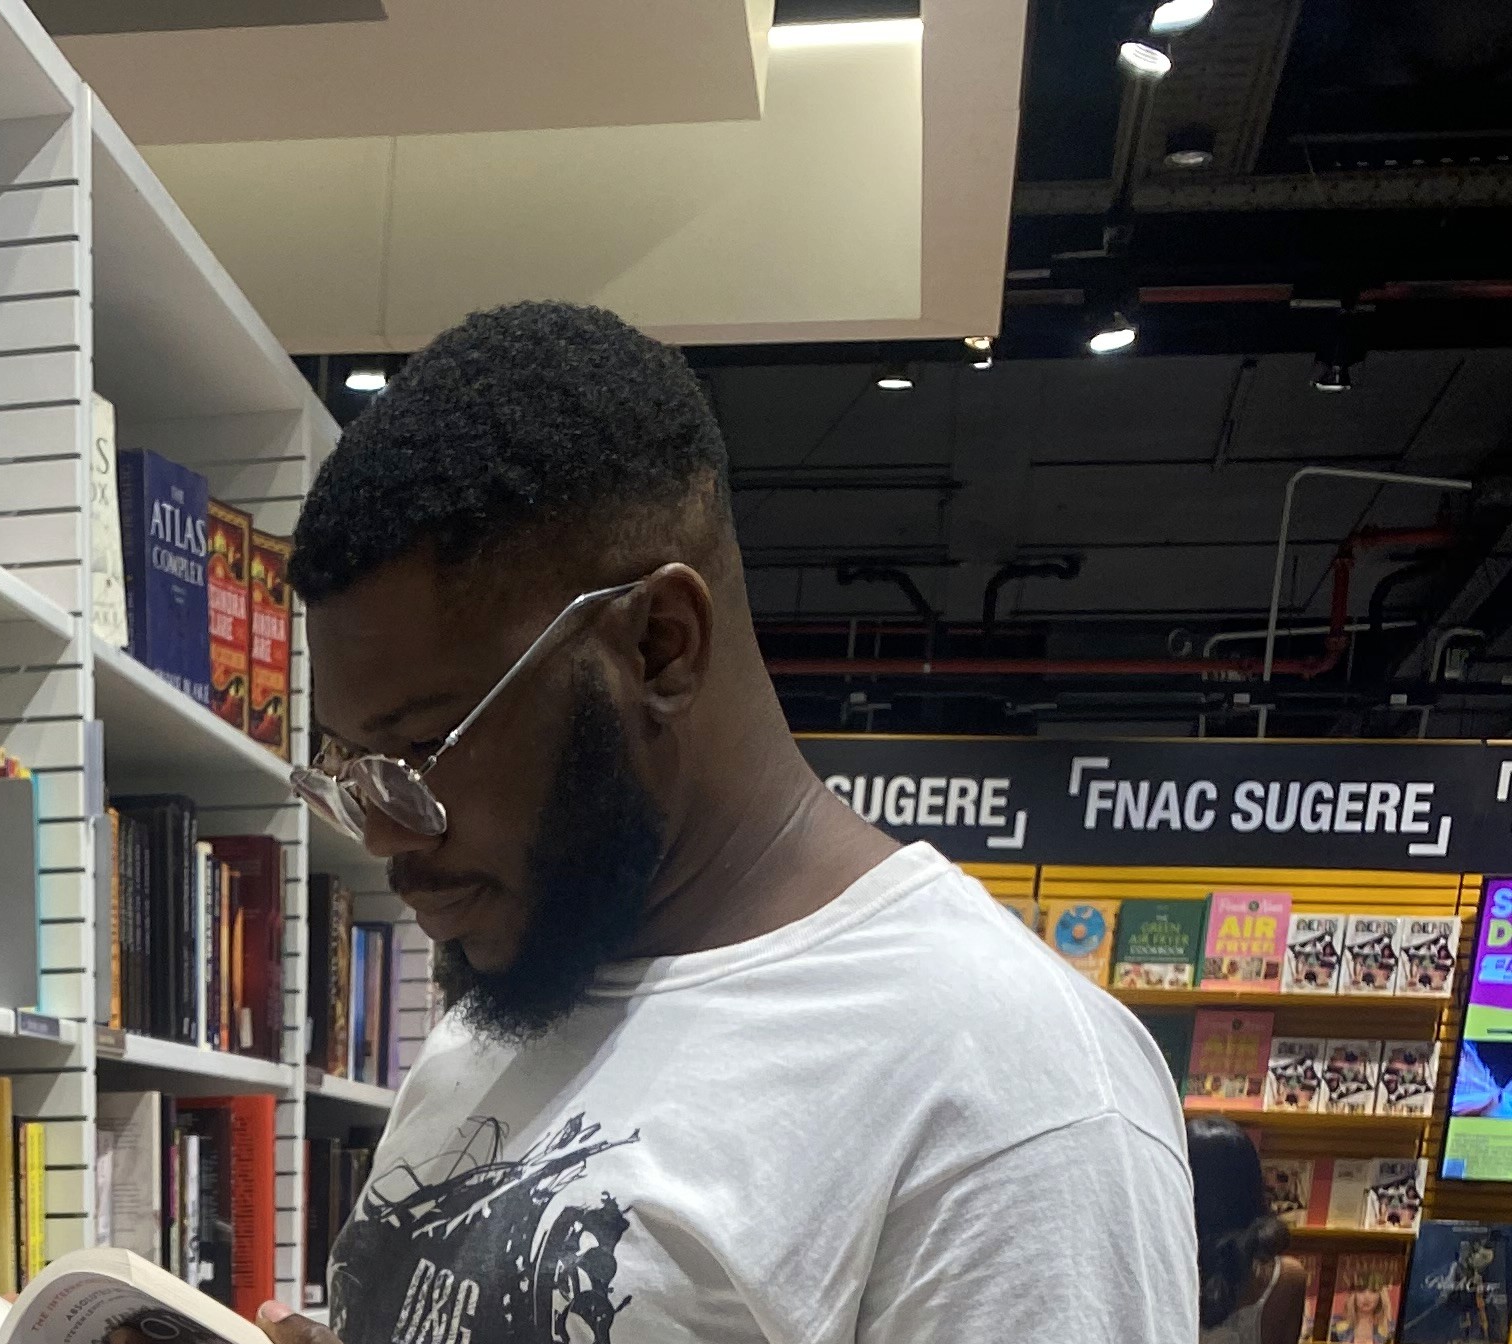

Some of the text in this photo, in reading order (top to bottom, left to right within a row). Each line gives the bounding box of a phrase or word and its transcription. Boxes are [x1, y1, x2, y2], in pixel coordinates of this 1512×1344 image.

[150, 499, 207, 558] ATLAS
[1083, 779, 1436, 836] FNAC SUGERE
[1218, 915, 1278, 939] AIR
